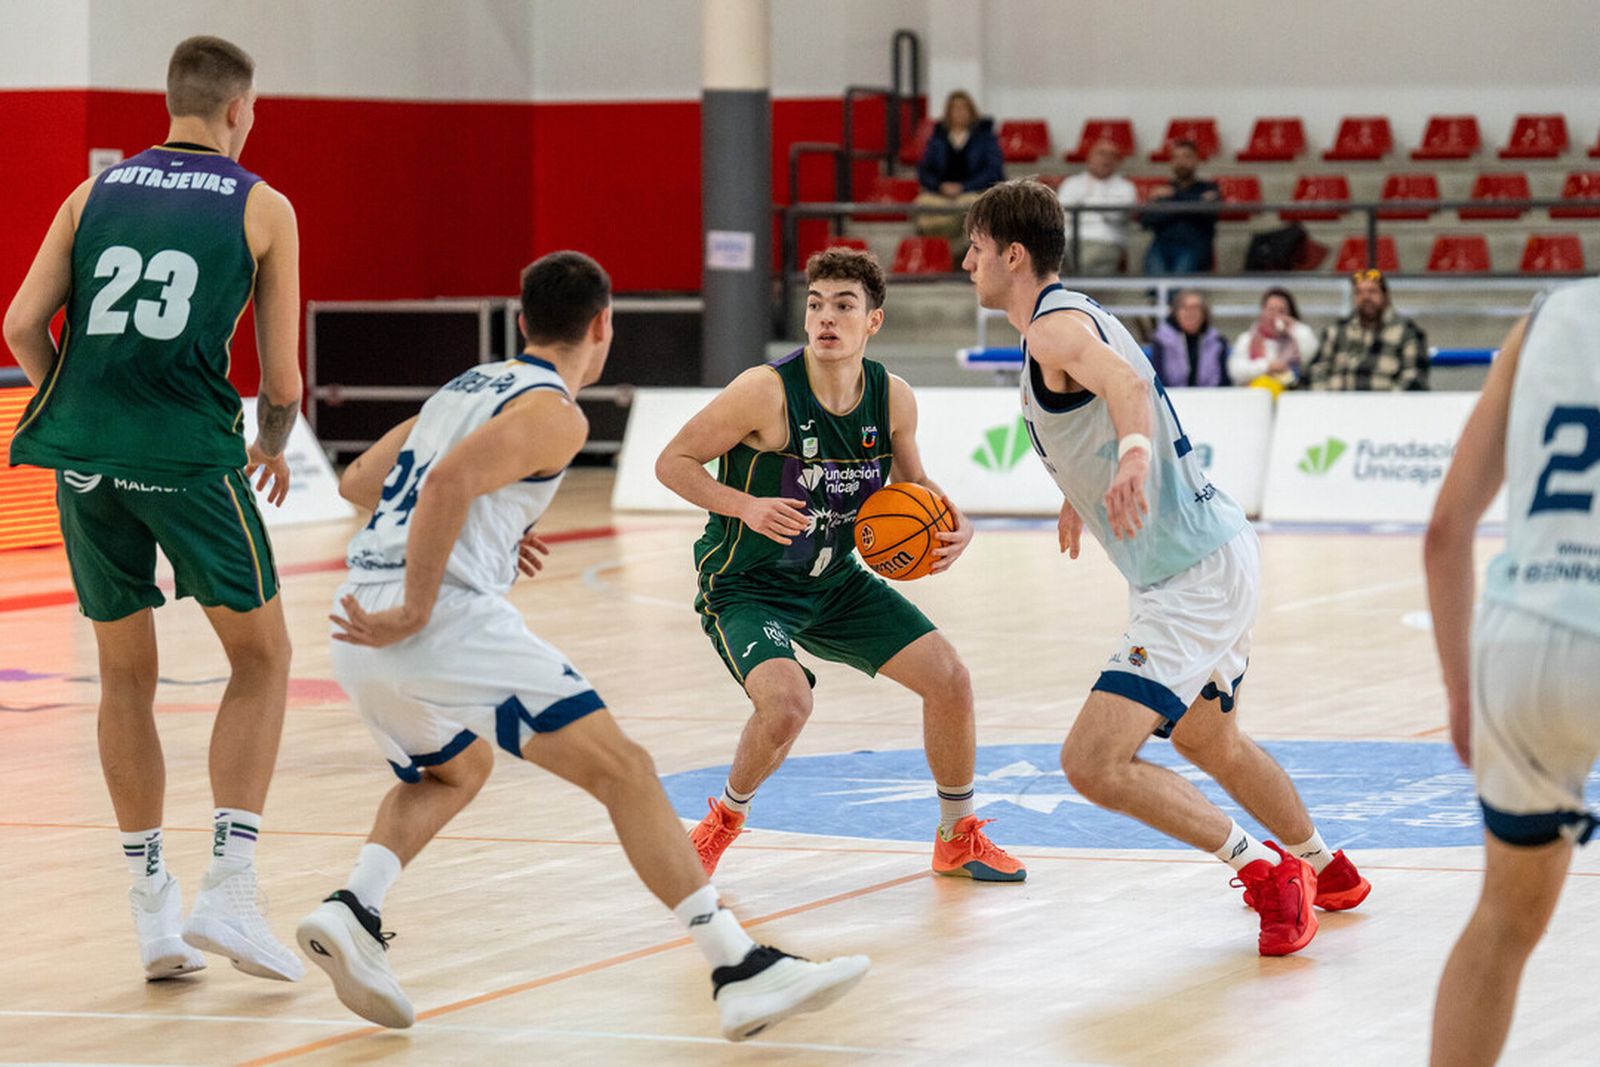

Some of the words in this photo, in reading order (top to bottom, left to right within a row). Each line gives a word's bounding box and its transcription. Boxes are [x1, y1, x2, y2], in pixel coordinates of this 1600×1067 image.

[86, 245, 199, 340] 23
[1357, 439, 1455, 459] Fundaci
[1354, 461, 1442, 488] Unicaja
[825, 479, 860, 497] nicaja
